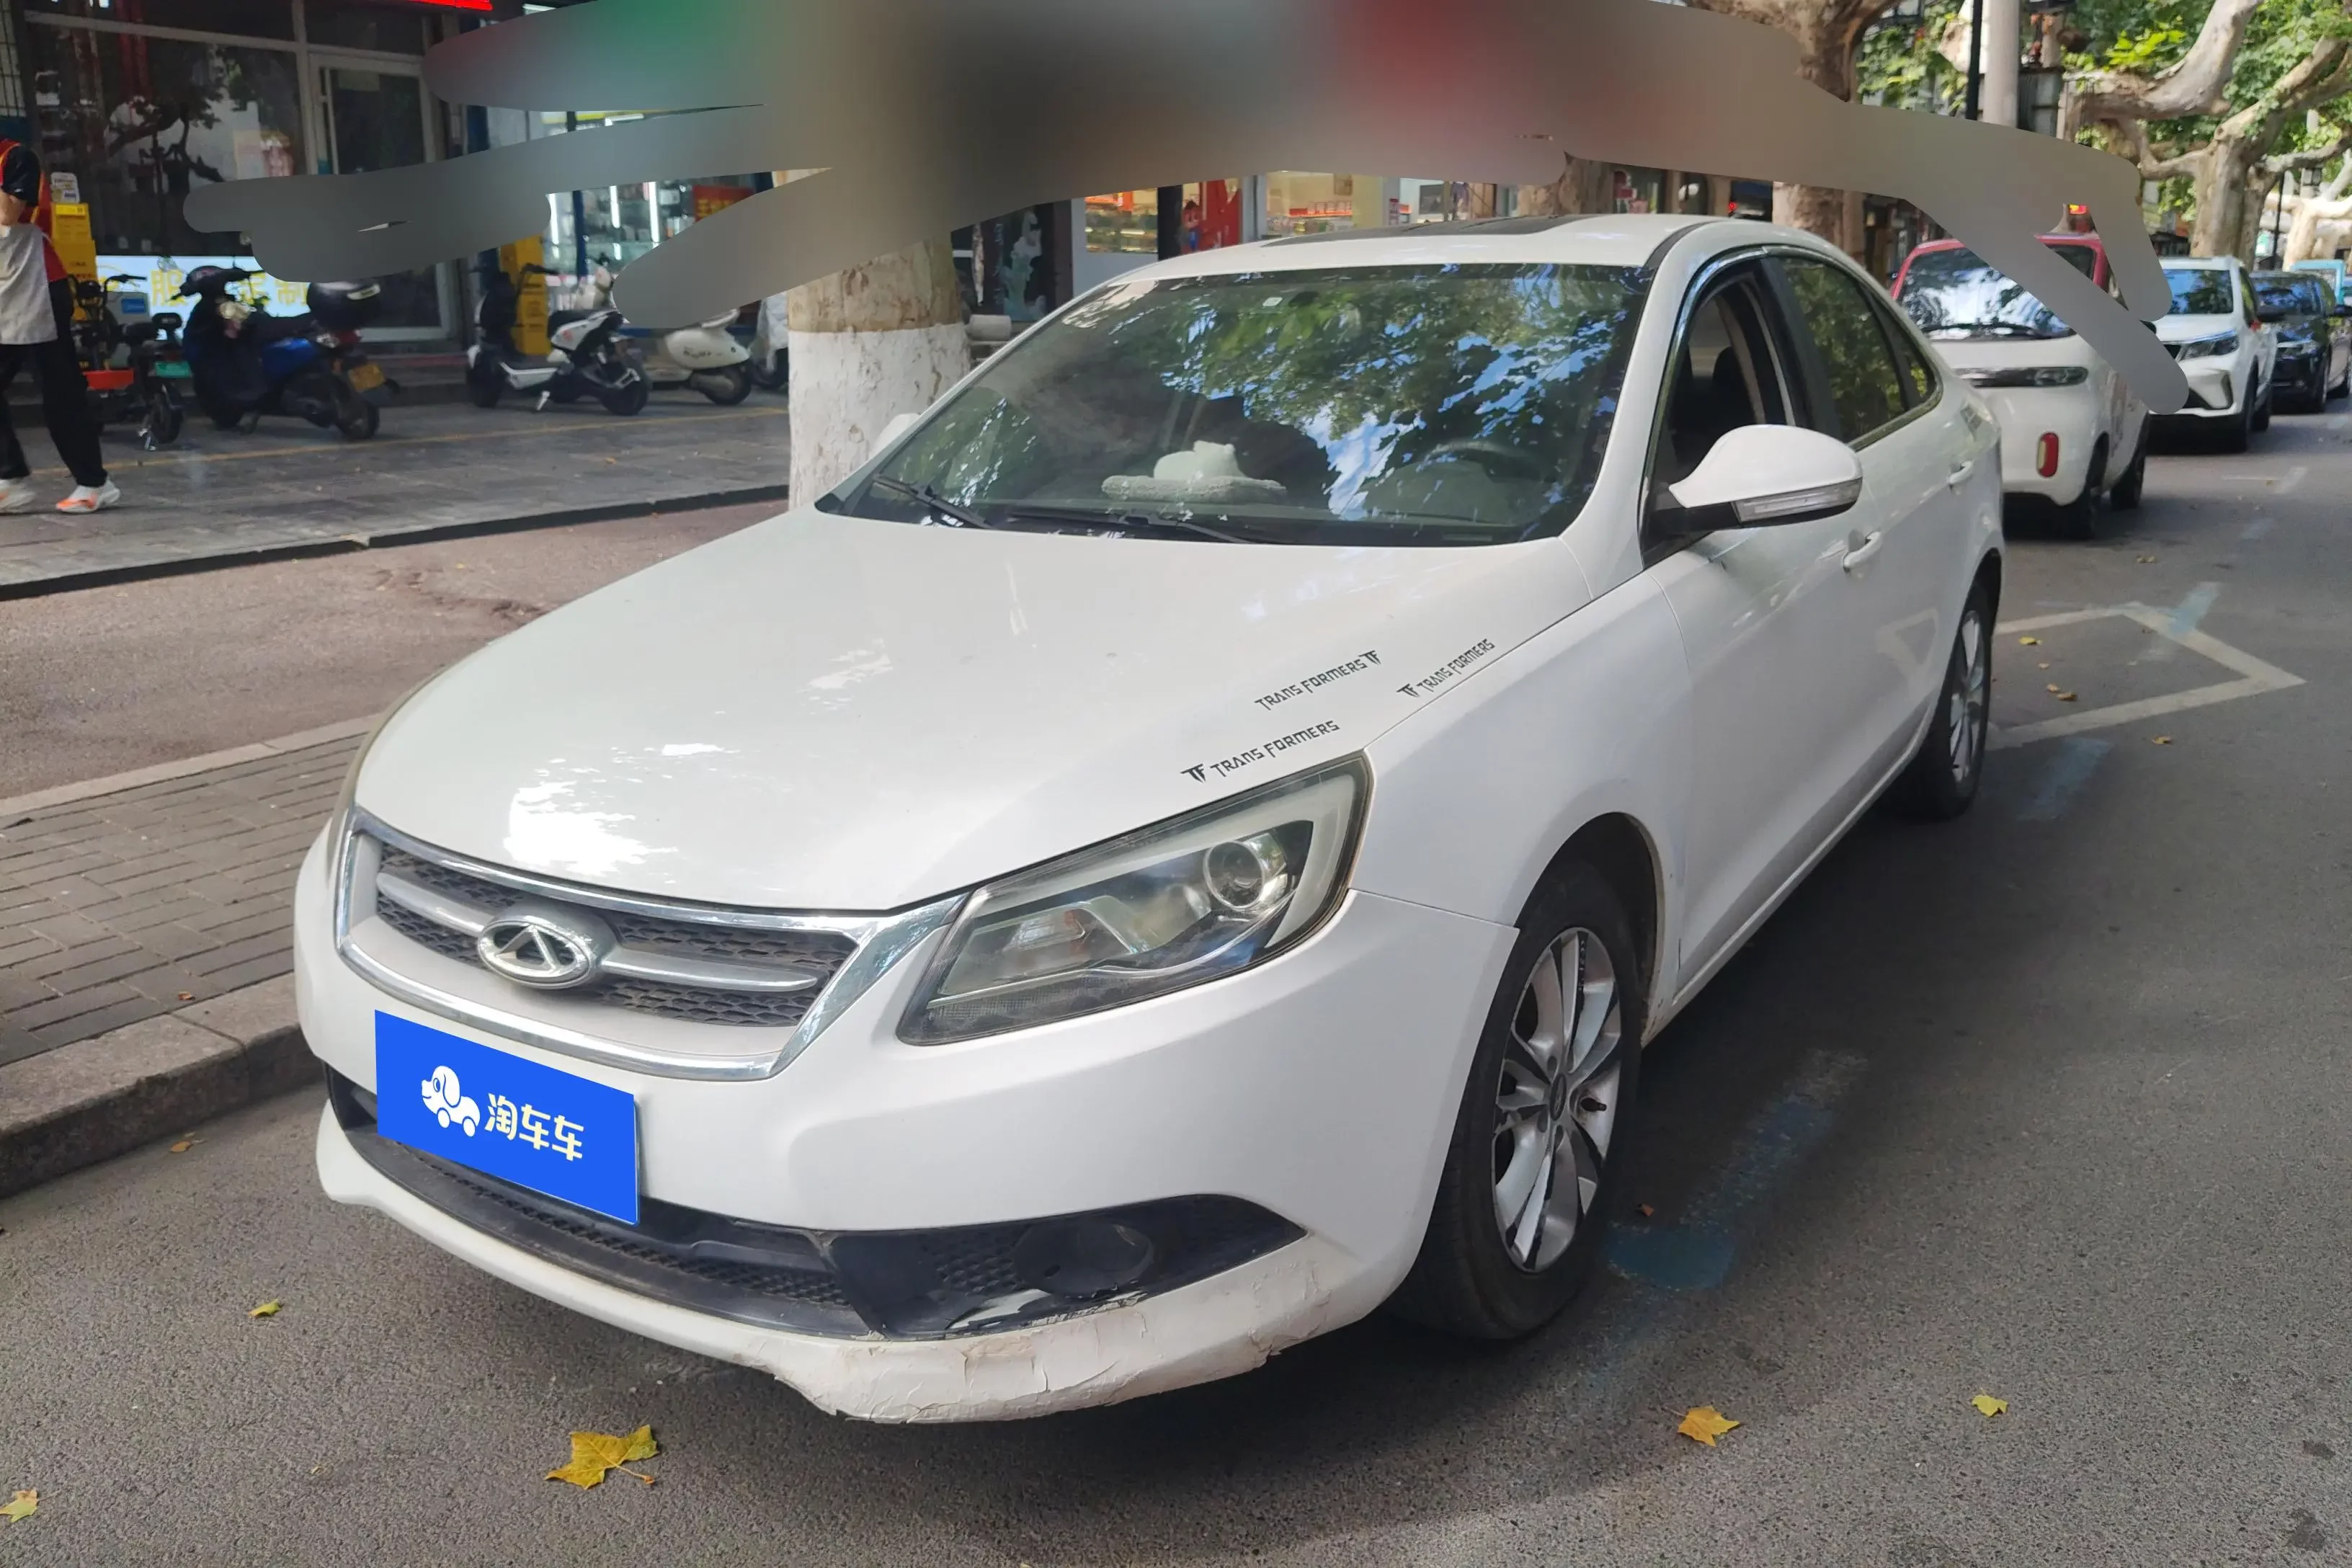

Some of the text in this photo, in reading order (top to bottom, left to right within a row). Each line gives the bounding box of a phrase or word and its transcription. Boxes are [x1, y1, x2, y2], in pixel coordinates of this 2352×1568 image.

[1254, 650, 1381, 710] TRANS FORMERS TF
[1415, 667, 1453, 692] TRANS
[1447, 638, 1495, 674] FORMERS
[1180, 721, 1340, 783] TF TRANS FORMERS
